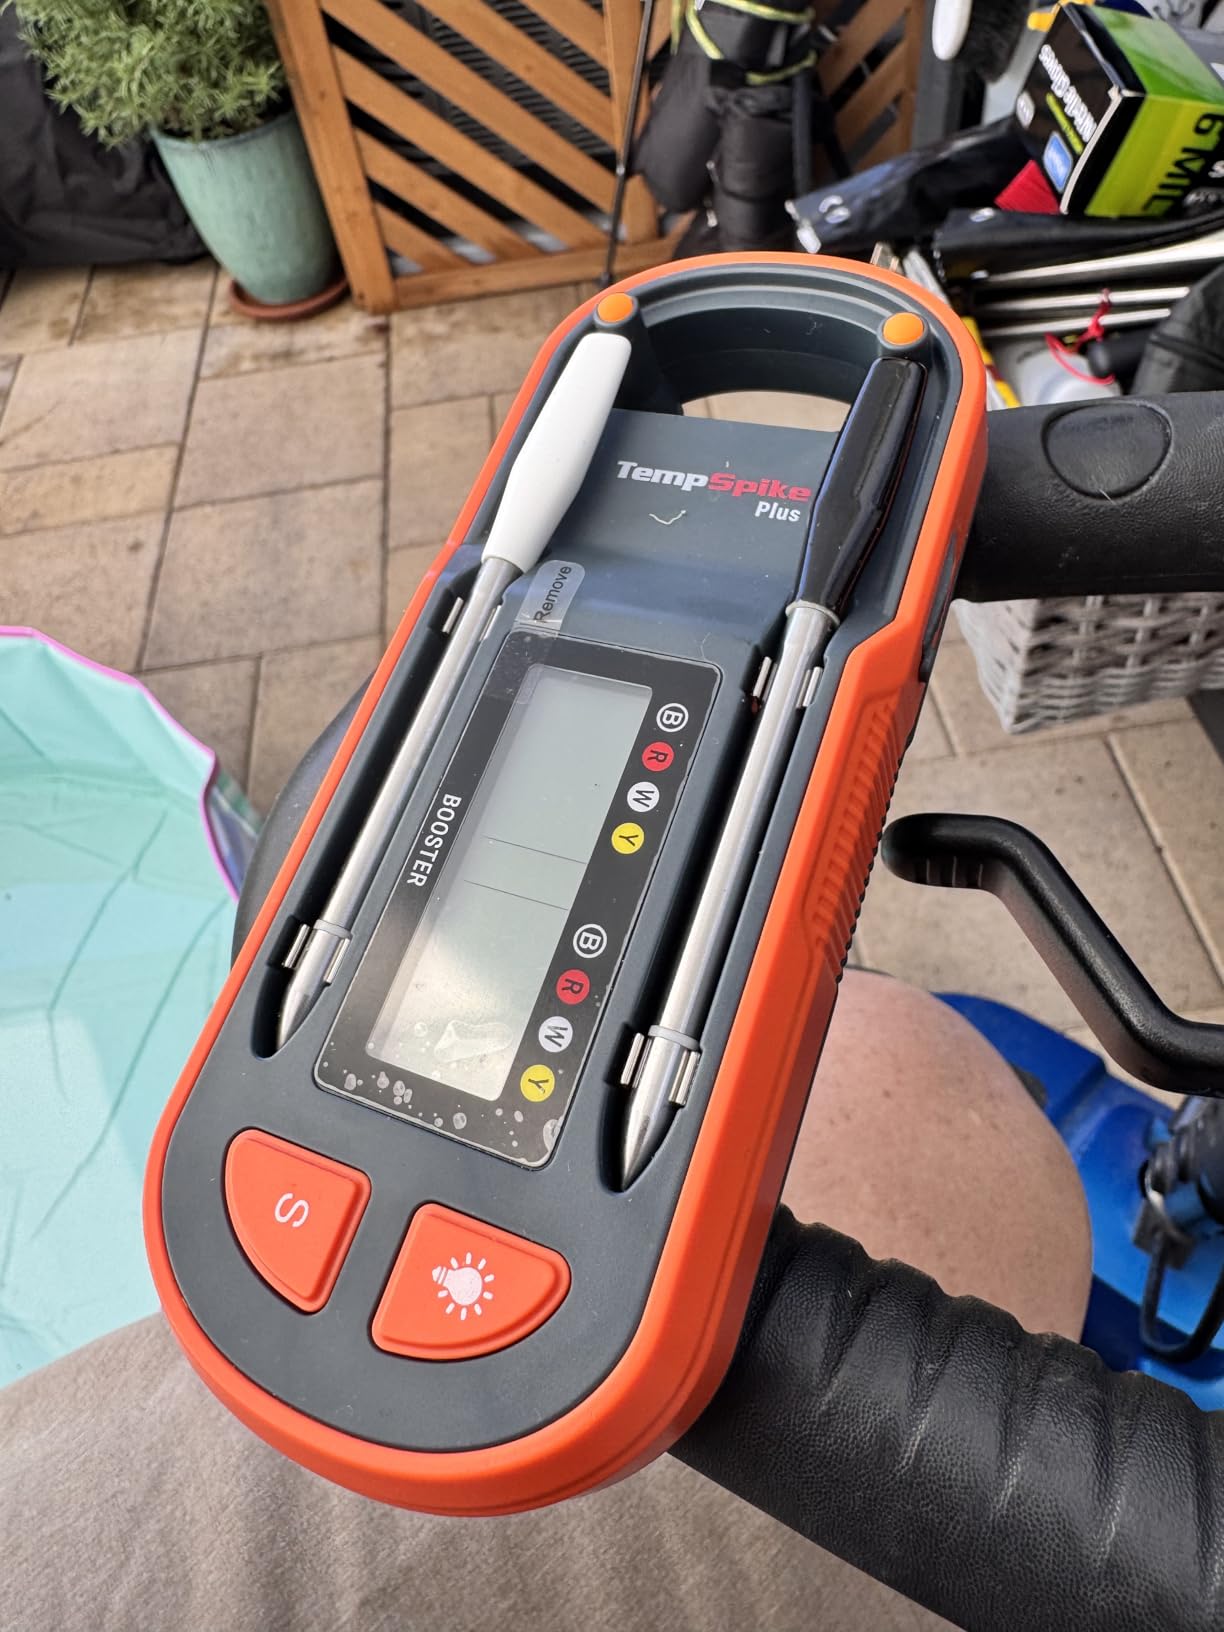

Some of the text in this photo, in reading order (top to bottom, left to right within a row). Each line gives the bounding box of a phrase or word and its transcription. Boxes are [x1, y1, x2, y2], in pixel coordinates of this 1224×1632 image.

[617, 460, 812, 503] TempSpike
[754, 501, 801, 523] Plus
[533, 566, 572, 624] Remove
[406, 793, 463, 887] BOOSTER
[274, 1191, 310, 1229] S
